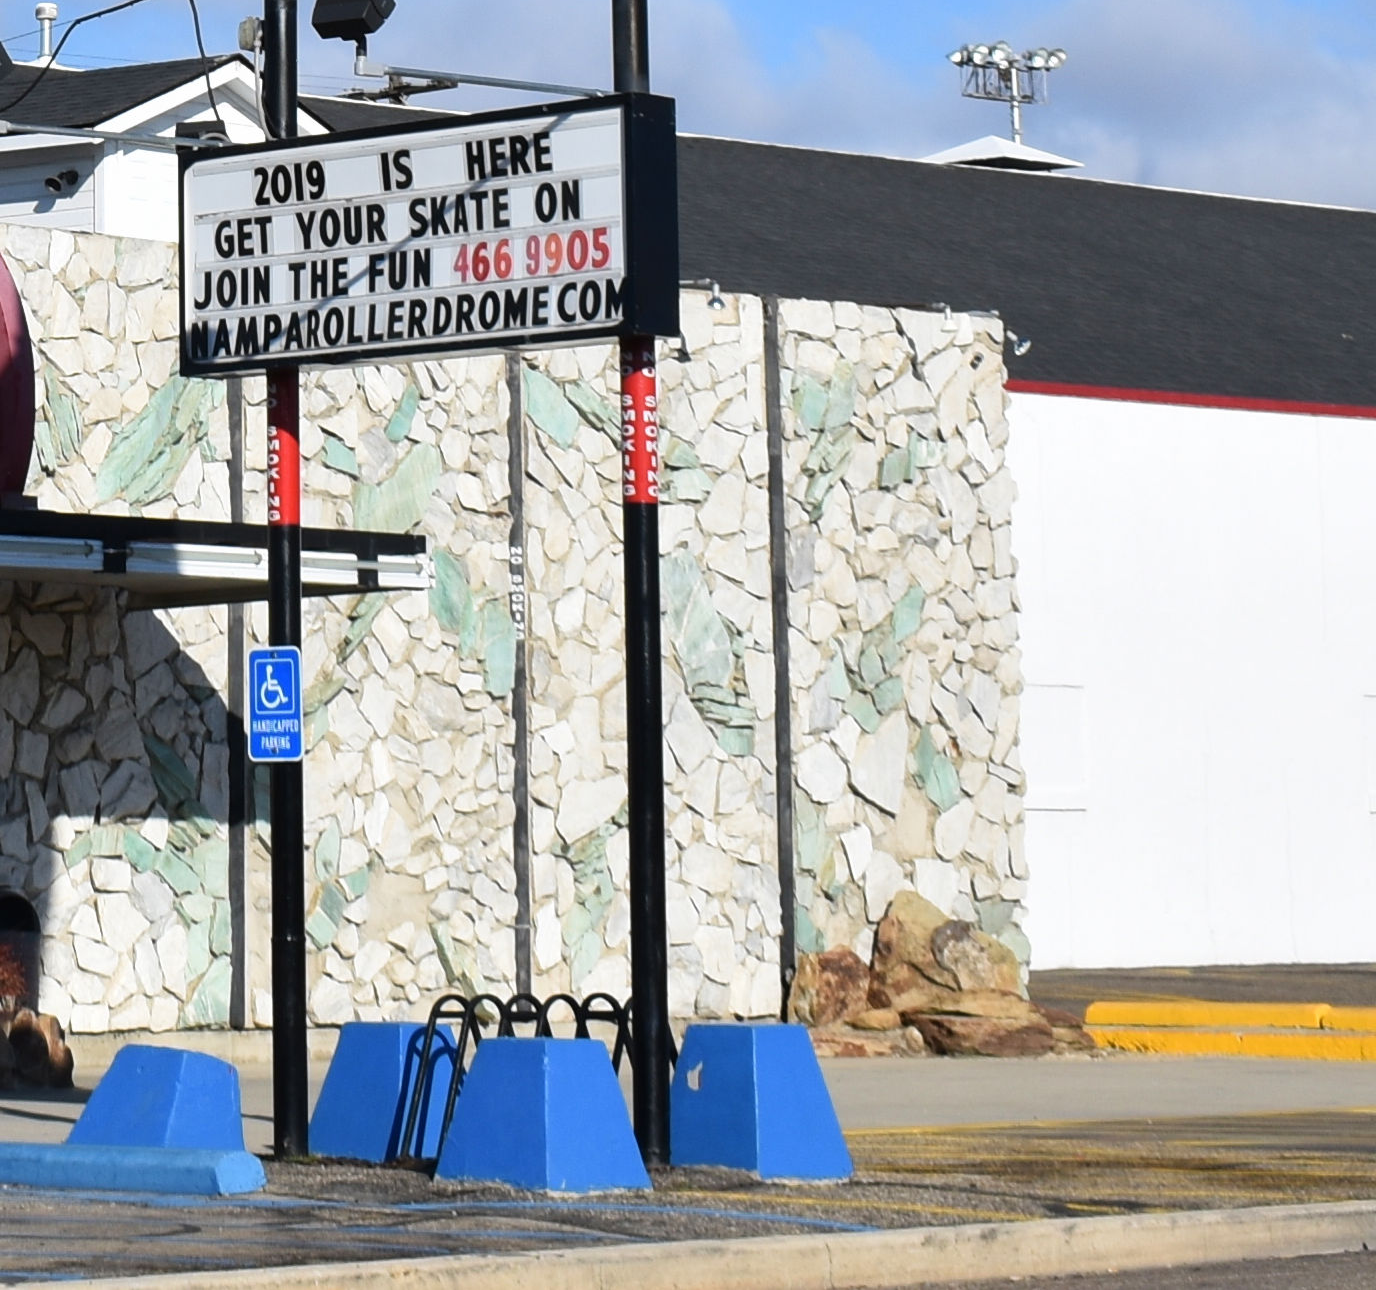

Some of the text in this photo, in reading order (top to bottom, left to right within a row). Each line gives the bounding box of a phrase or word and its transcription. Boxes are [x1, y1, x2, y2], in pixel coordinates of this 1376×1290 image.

[254, 132, 553, 206] 2019 IS HERE
[214, 179, 580, 259] GET YOUR SKATE ON
[194, 227, 610, 310] JOIN THE FUN 466 9905
[252, 718, 299, 733] HANDICAPPED
[261, 735, 291, 750] PARKING
